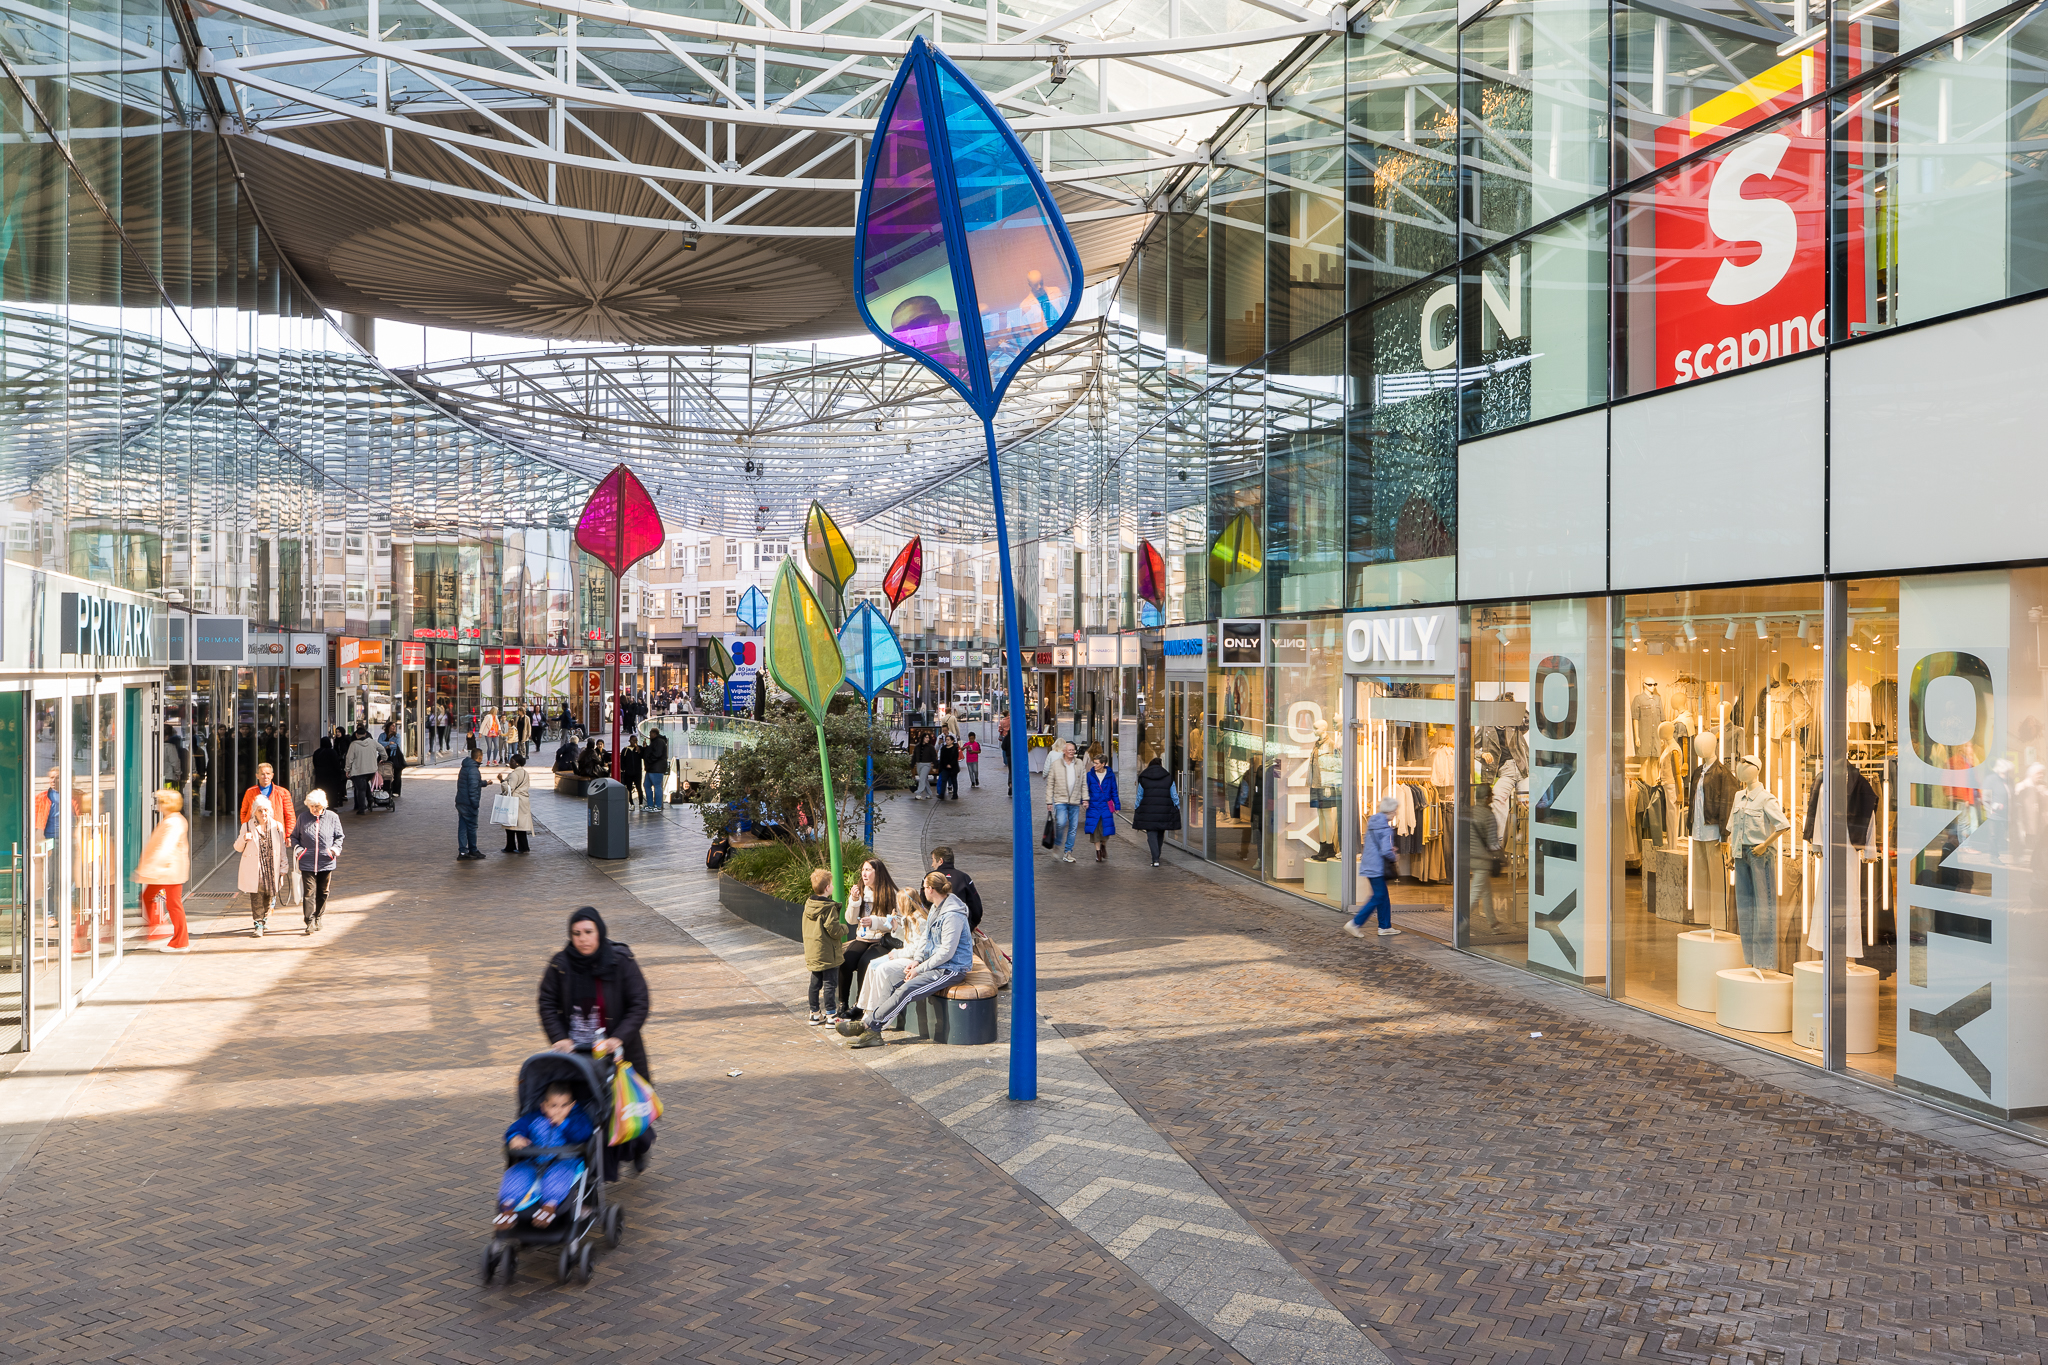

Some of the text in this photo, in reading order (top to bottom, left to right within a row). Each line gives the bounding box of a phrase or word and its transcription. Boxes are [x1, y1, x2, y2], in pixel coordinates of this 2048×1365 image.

[78, 592, 153, 657] PRIMARK
[1224, 638, 1260, 648] ONLY
[1347, 615, 1445, 663] ONLY
[1535, 655, 1577, 971] ONLY
[1909, 651, 1995, 1100] ONLY
